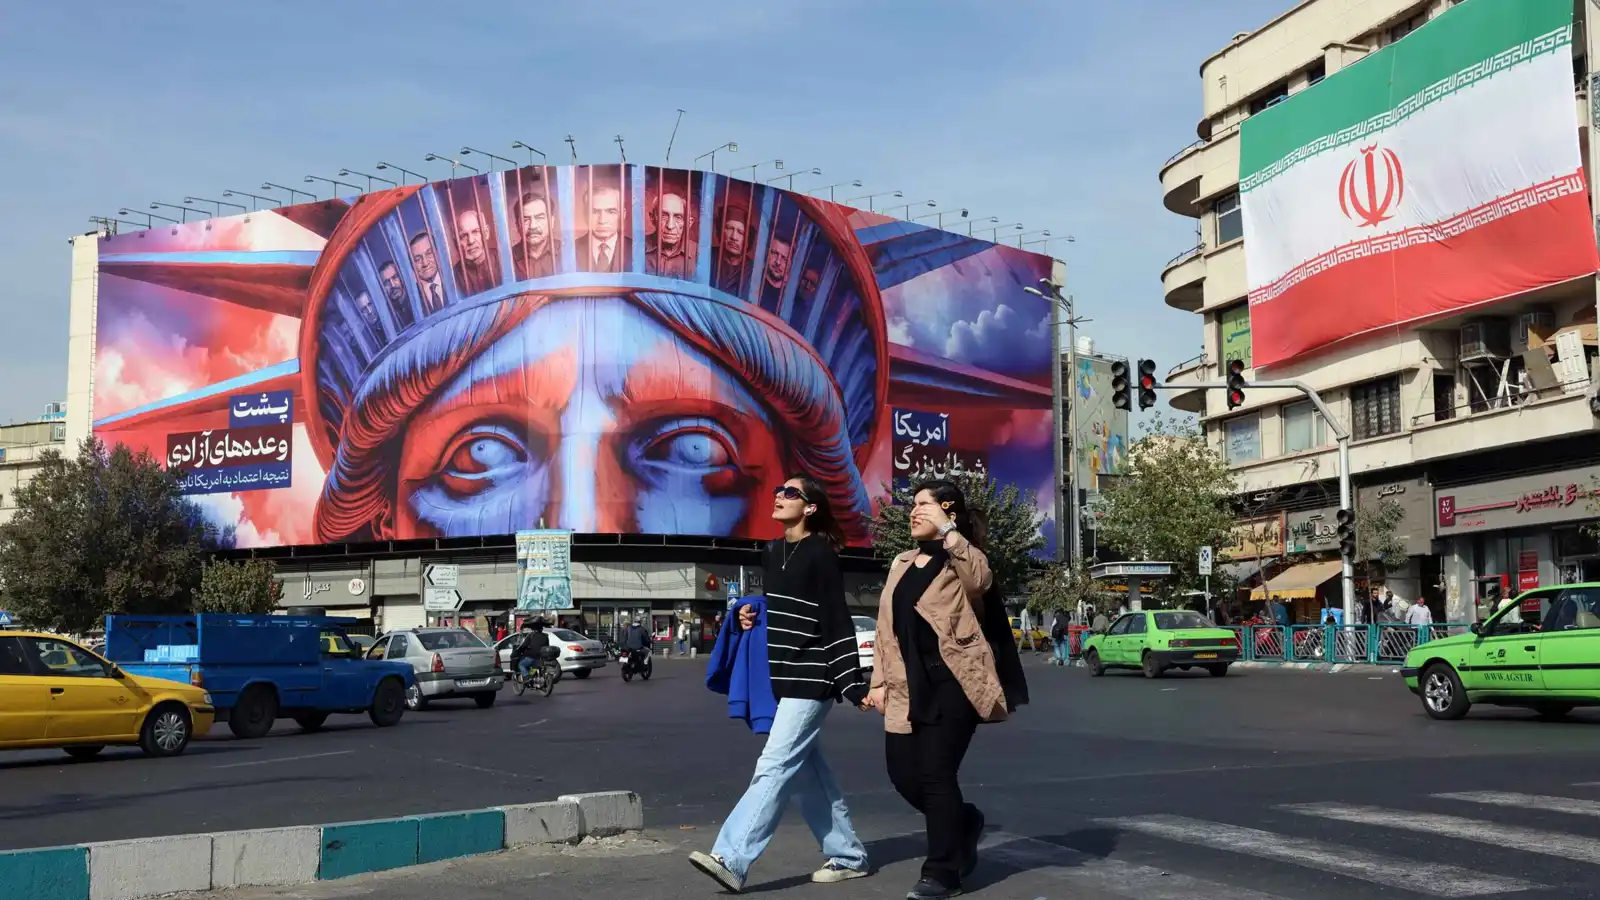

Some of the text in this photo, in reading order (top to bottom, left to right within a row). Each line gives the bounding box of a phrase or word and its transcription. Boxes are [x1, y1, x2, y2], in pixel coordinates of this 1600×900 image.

[233, 393, 289, 424] پشت
[894, 410, 950, 446] آمریکا
[167, 429, 213, 469] آزادی
[894, 444, 934, 480] بزرگ
[194, 469, 224, 490] آمریکا
[222, 474, 232, 488] به
[233, 469, 262, 485] اعتماد
[262, 468, 289, 485] نتیجه
